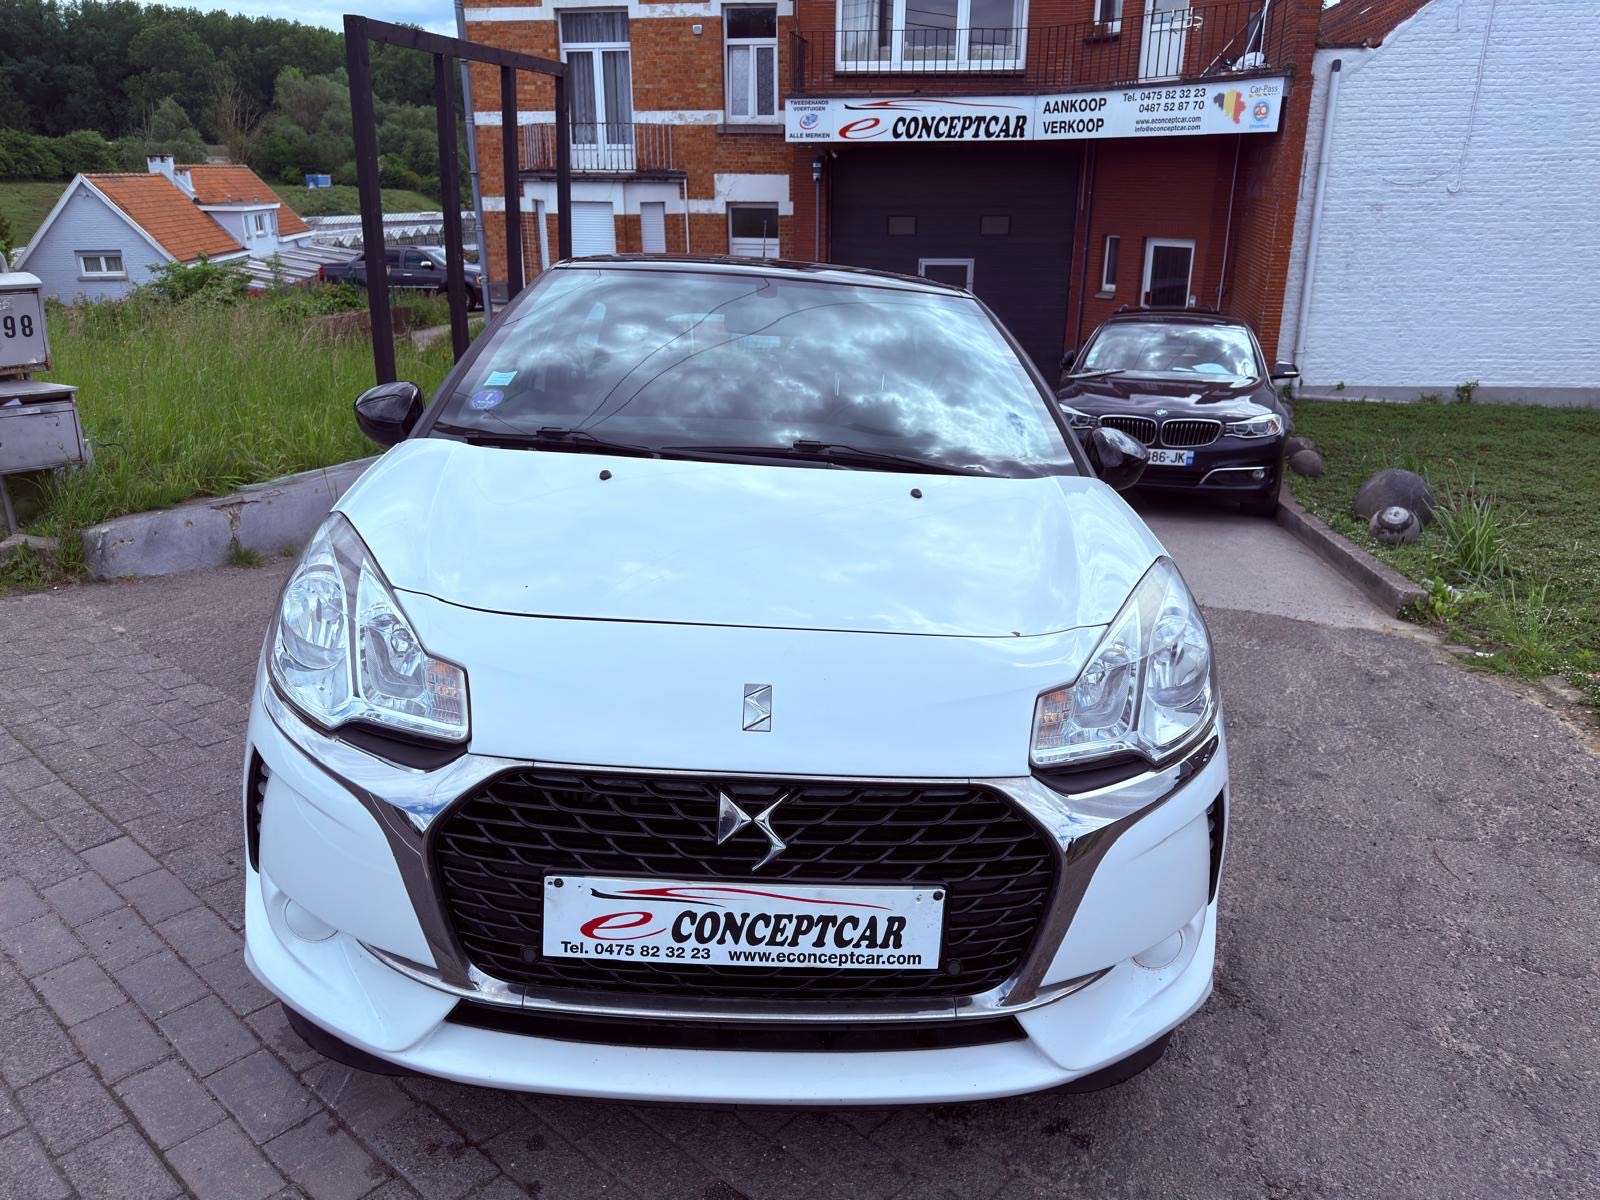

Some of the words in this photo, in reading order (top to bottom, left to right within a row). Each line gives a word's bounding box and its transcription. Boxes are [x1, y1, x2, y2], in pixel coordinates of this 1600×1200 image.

[1123, 93, 1137, 102] Tel.
[1140, 91, 1162, 101] 0475
[1165, 90, 1177, 99] 82
[1179, 89, 1191, 99] 32
[1193, 88, 1206, 98] 23
[1250, 85, 1279, 94] Car-Pass
[1043, 98, 1107, 114] AANKOOP
[1139, 103, 1161, 113] 0487
[1163, 102, 1175, 112] 52
[1177, 101, 1190, 111] 87
[1193, 100, 1205, 110] 70
[892, 115, 1027, 140] CONCEPTCAR
[1043, 117, 1105, 135] VERKOOP
[1135, 115, 1202, 125] www.econceptcar.com
[1134, 124, 1201, 133] info@econceptcar.com
[3, 314, 34, 339] 98
[1148, 451, 1185, 464] 86-JK
[671, 909, 907, 950] CONCEPTCAR
[560, 940, 590, 955] Tel.
[593, 943, 636, 957] 0475
[639, 945, 661, 958] 82
[665, 946, 686, 960] 32
[690, 948, 711, 960] 23
[727, 950, 923, 967] www.econceptcar.com
